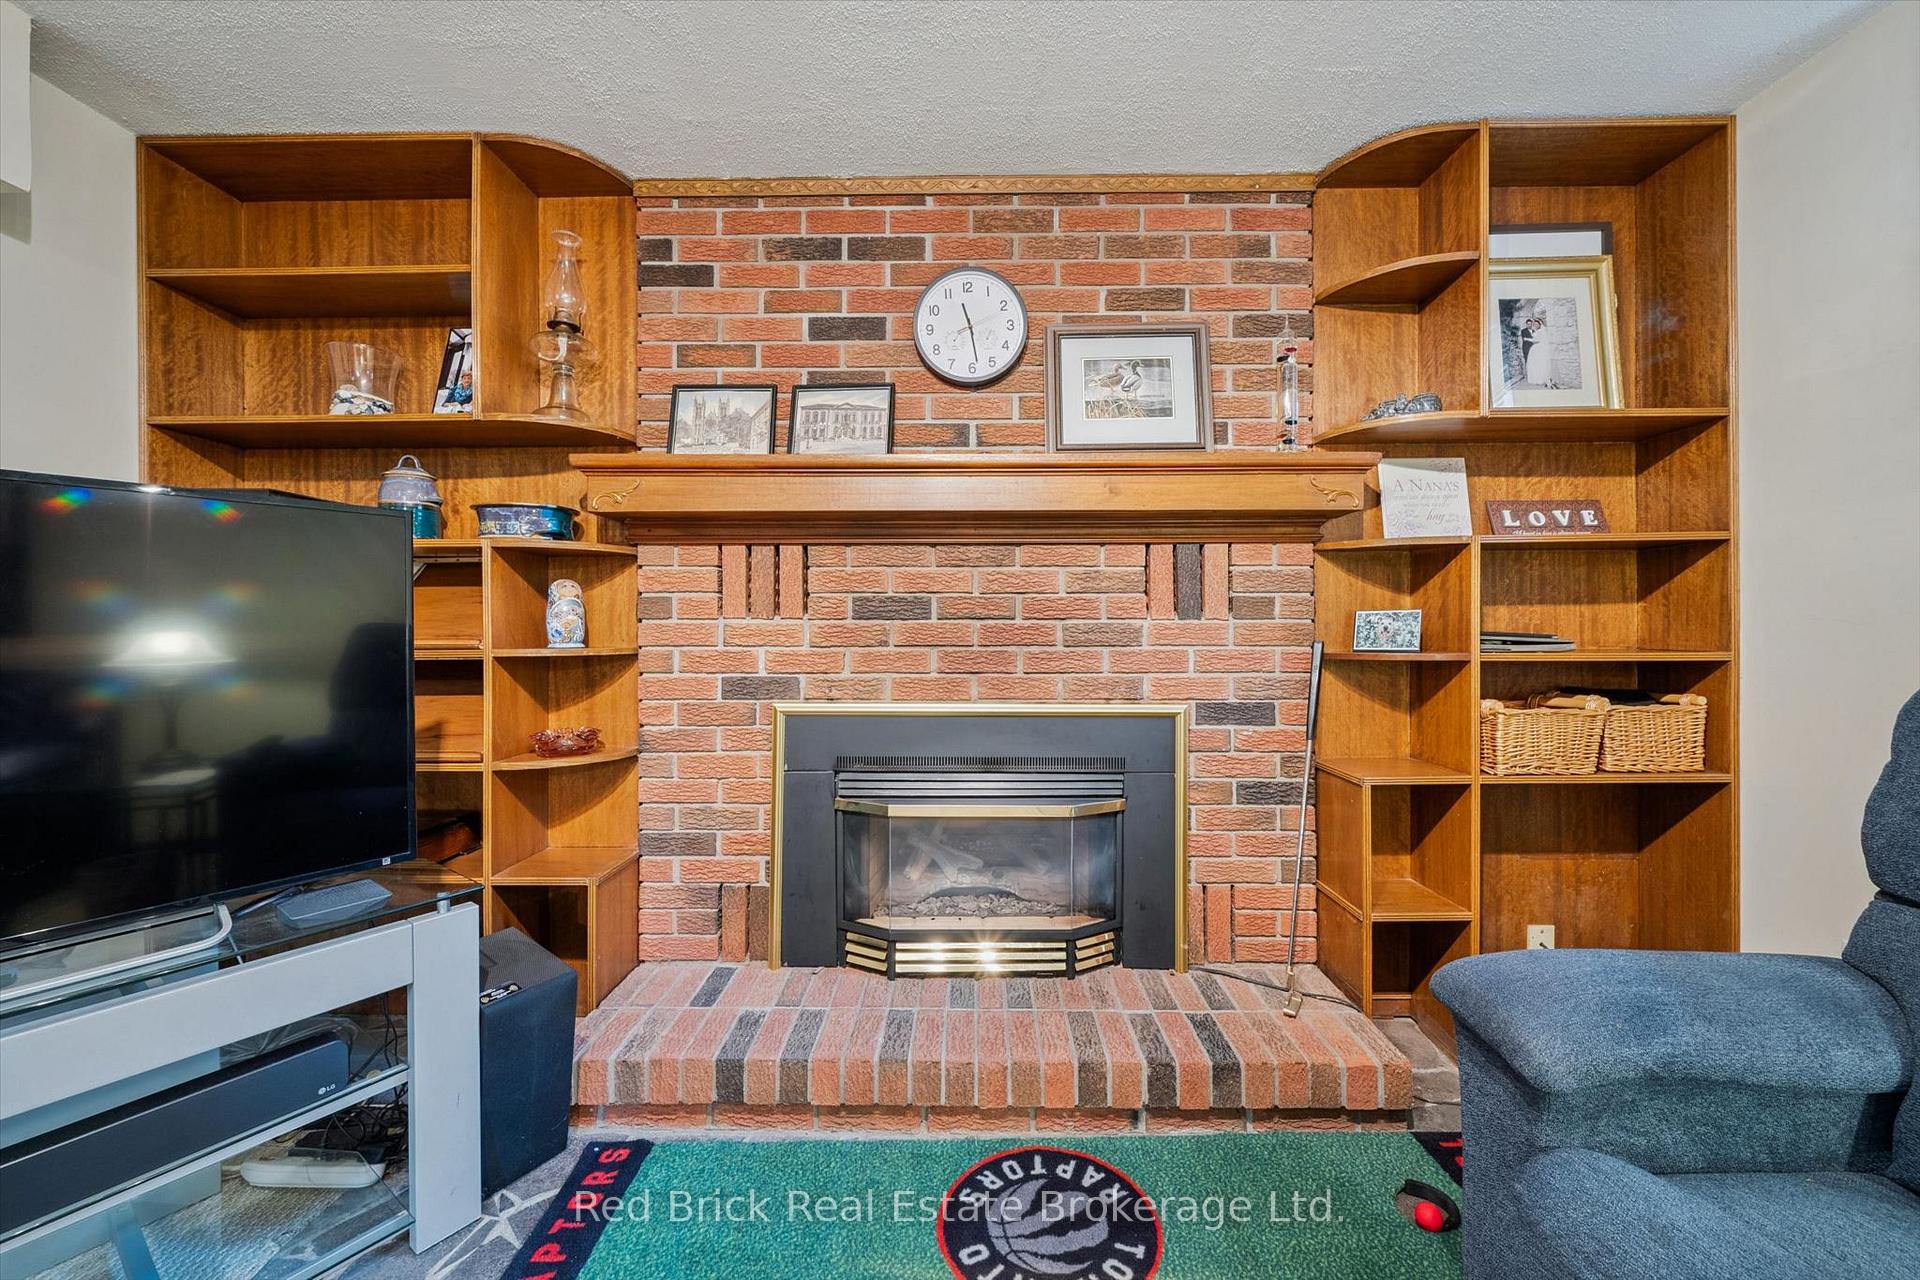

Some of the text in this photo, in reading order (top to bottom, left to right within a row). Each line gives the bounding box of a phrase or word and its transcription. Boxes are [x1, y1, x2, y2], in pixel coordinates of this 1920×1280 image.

[962, 281, 973, 293] 12
[986, 285, 990, 297] 1
[944, 288, 952, 299] 11
[928, 304, 940, 316] 10
[999, 300, 1008, 311] 2
[925, 324, 934, 336] 9
[1006, 319, 1015, 331] 3
[932, 344, 941, 355] 8
[1001, 340, 1010, 351] 4
[947, 358, 956, 370] 7
[988, 356, 996, 367] 5
[968, 362, 976, 374] 6
[1393, 479, 1404, 492] A
[1502, 509, 1599, 527] LOVE
[958, 1155, 1129, 1208] RAPTORS
